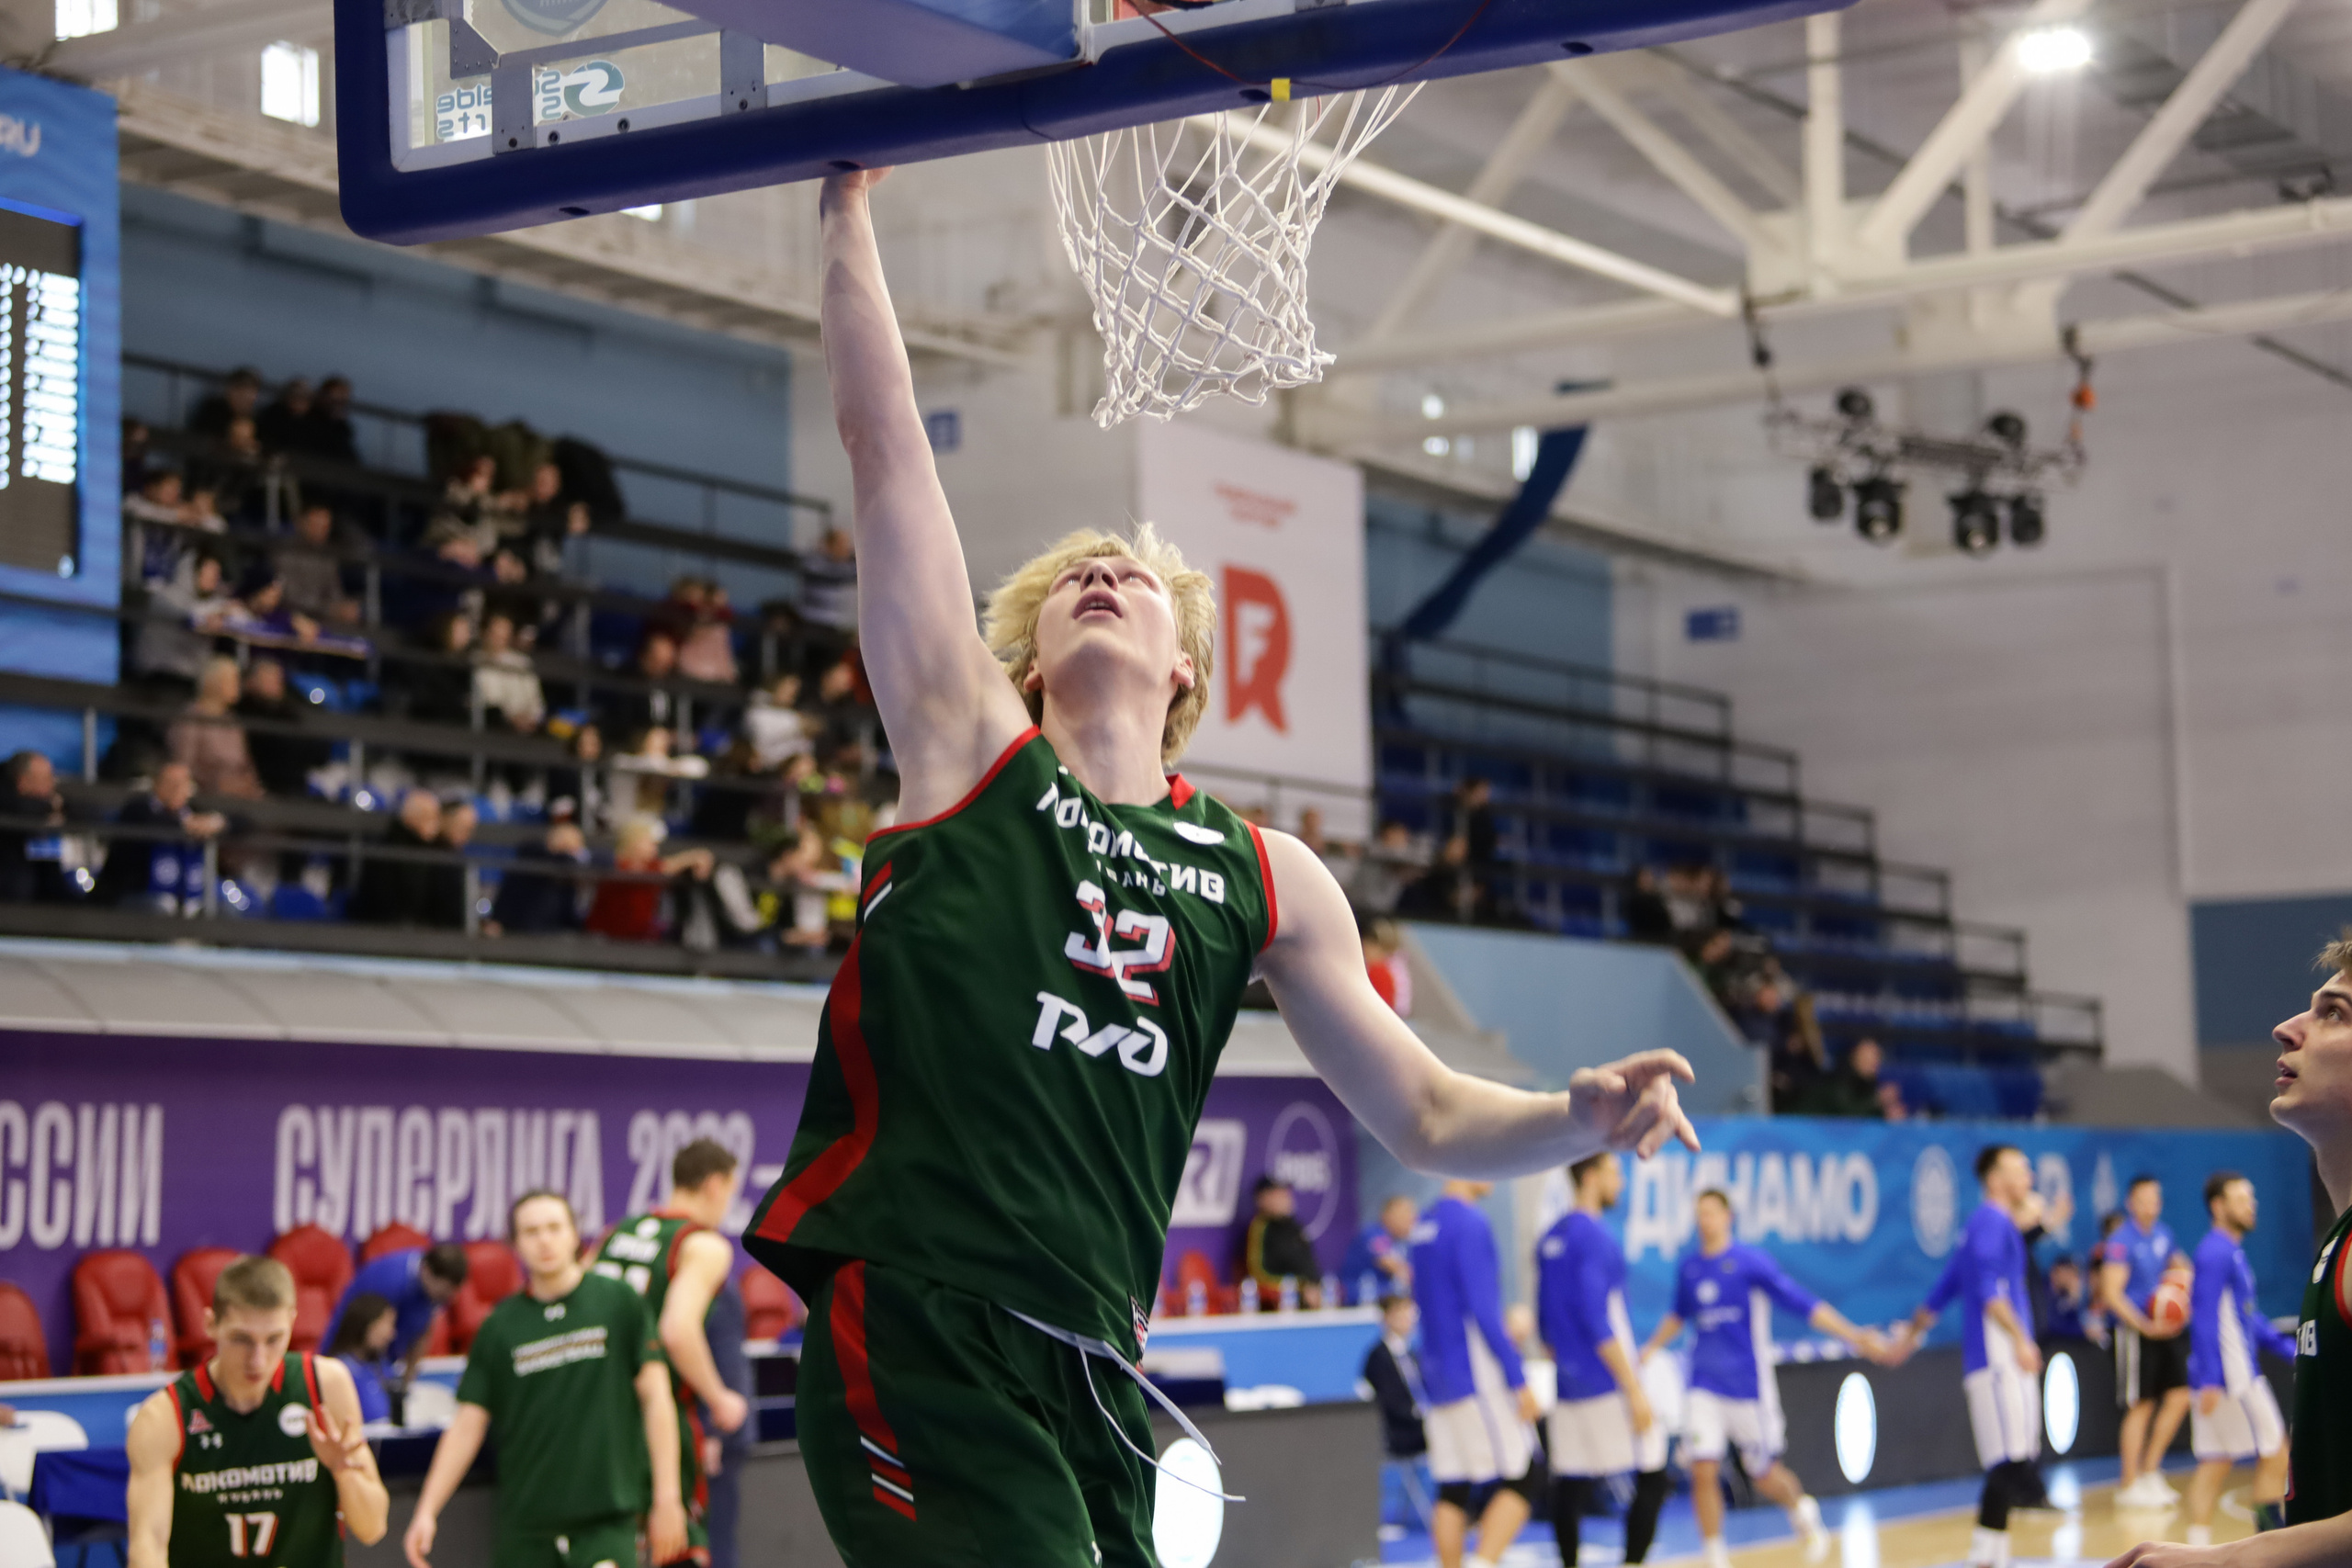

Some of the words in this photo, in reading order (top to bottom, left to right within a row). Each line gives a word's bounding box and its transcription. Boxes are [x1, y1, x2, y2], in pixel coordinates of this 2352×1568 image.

[1064, 880, 1176, 1006] 32
[1624, 1151, 1880, 1264] ДИНАМО
[181, 1457, 319, 1494] ЛОКОМОТИВ
[225, 1511, 279, 1557] 17
